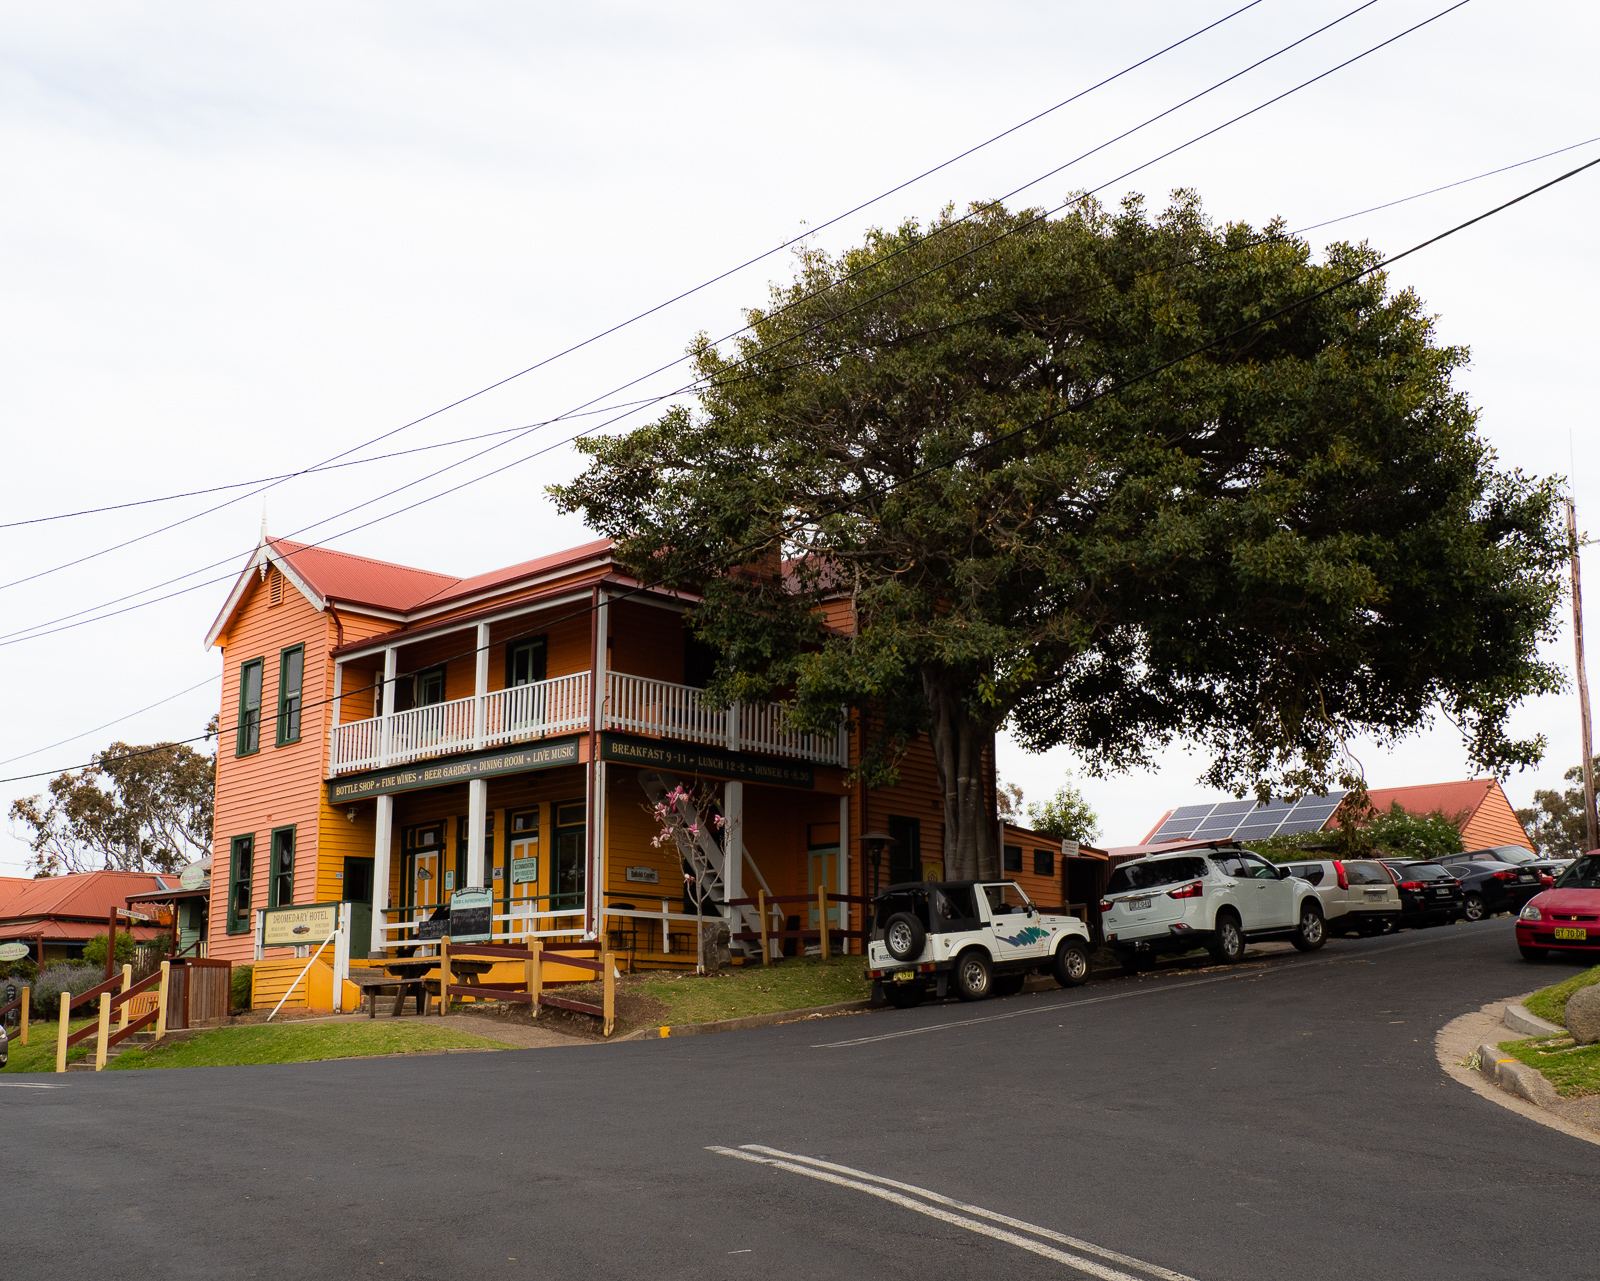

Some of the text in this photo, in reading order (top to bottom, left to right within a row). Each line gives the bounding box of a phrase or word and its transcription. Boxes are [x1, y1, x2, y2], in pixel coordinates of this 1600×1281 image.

[335, 746, 574, 796] BOTTLE SHOP FINE WINES BEER GARDEN DINING ROOM LIVE MUSIC
[611, 742, 664, 760] BREAKFAST
[698, 756, 723, 769] LUNCH
[755, 765, 782, 778] DINNER
[273, 910, 328, 924] DROMEDARY HOTEL
[1555, 929, 1585, 938] BY 70 DR
